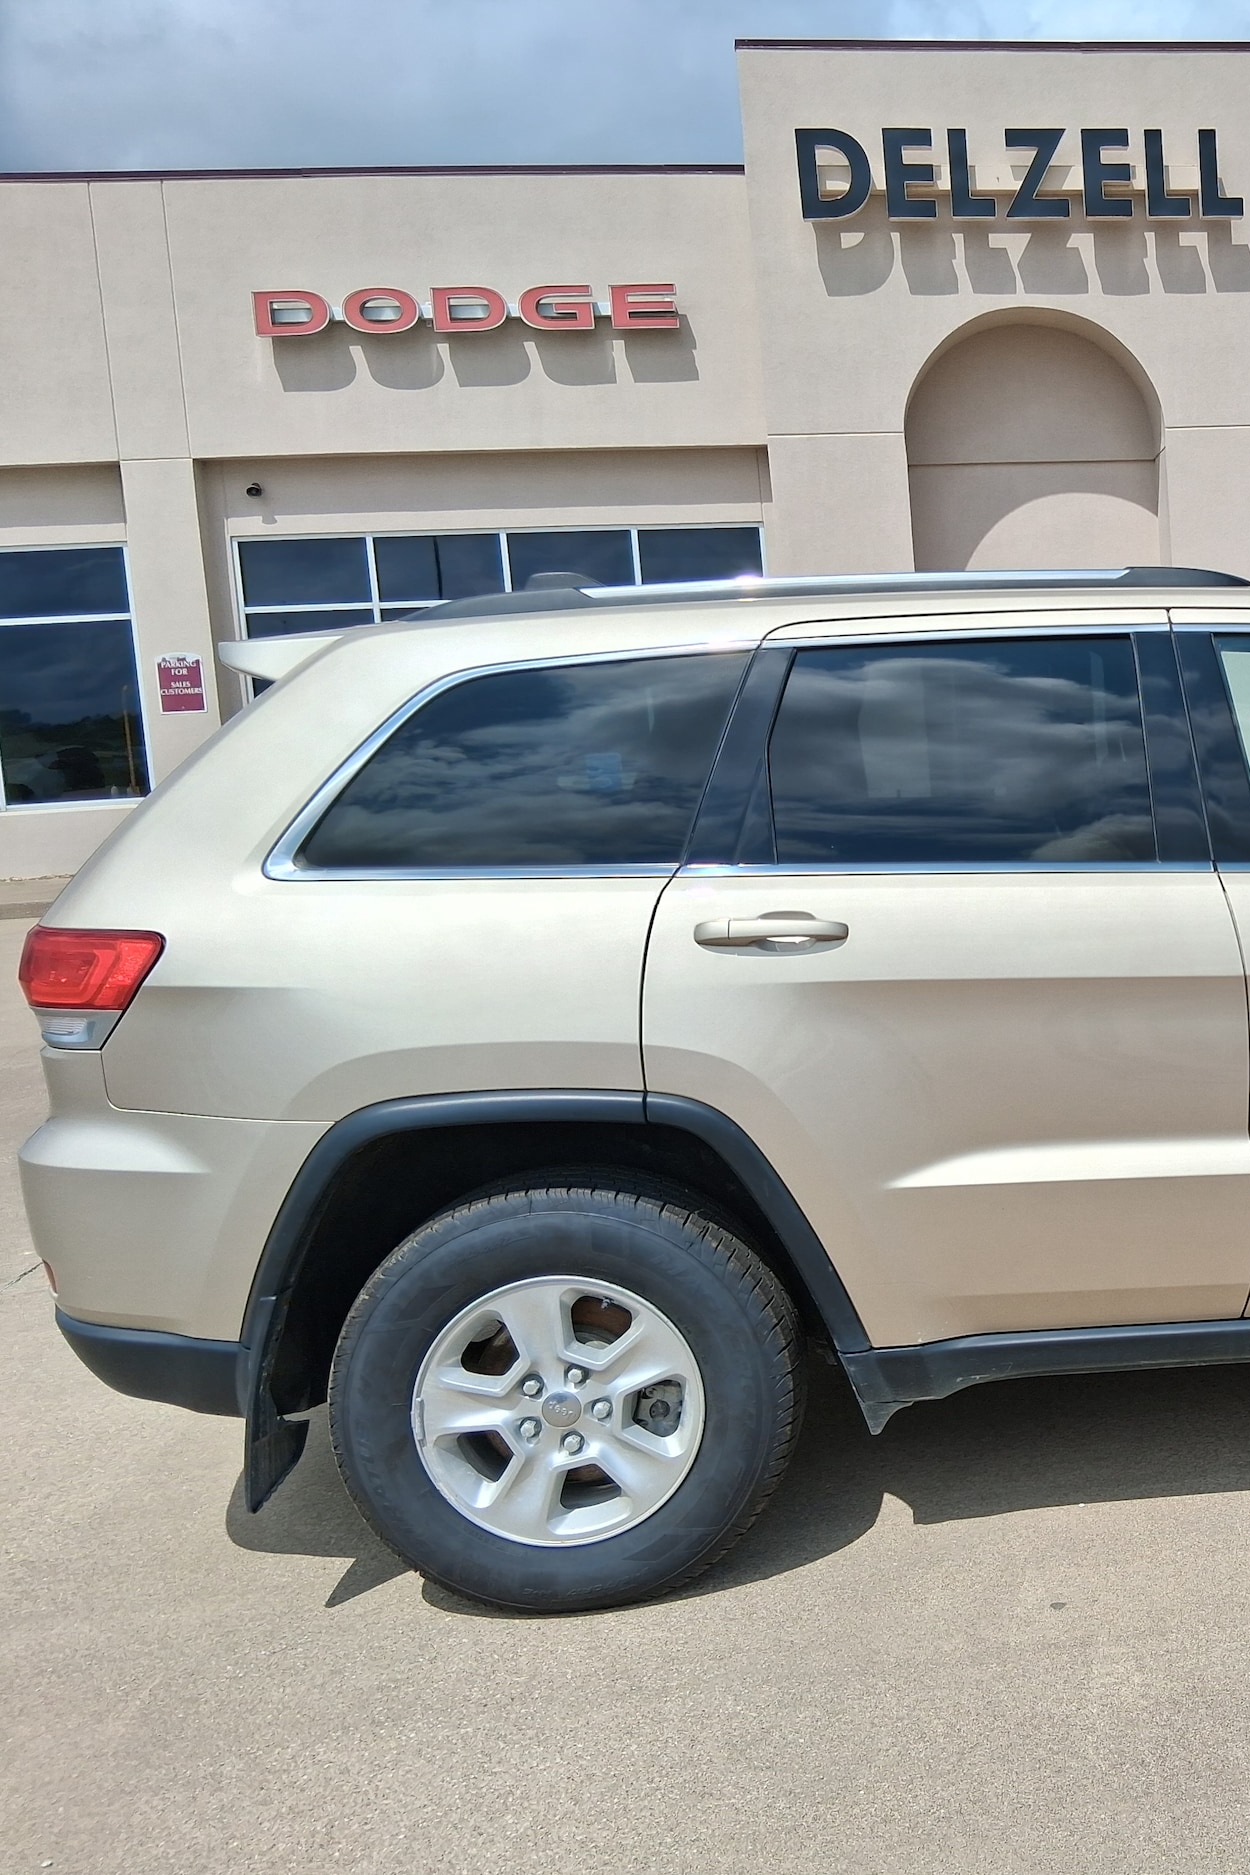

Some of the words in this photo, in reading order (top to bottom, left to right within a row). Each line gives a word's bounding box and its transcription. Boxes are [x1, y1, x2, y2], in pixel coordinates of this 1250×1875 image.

[794, 127, 1244, 221] DELZELL
[251, 283, 680, 338] DODGE
[160, 660, 197, 668] PARKING
[171, 668, 188, 676] FOR
[160, 687, 203, 695] CUSTOMERS
